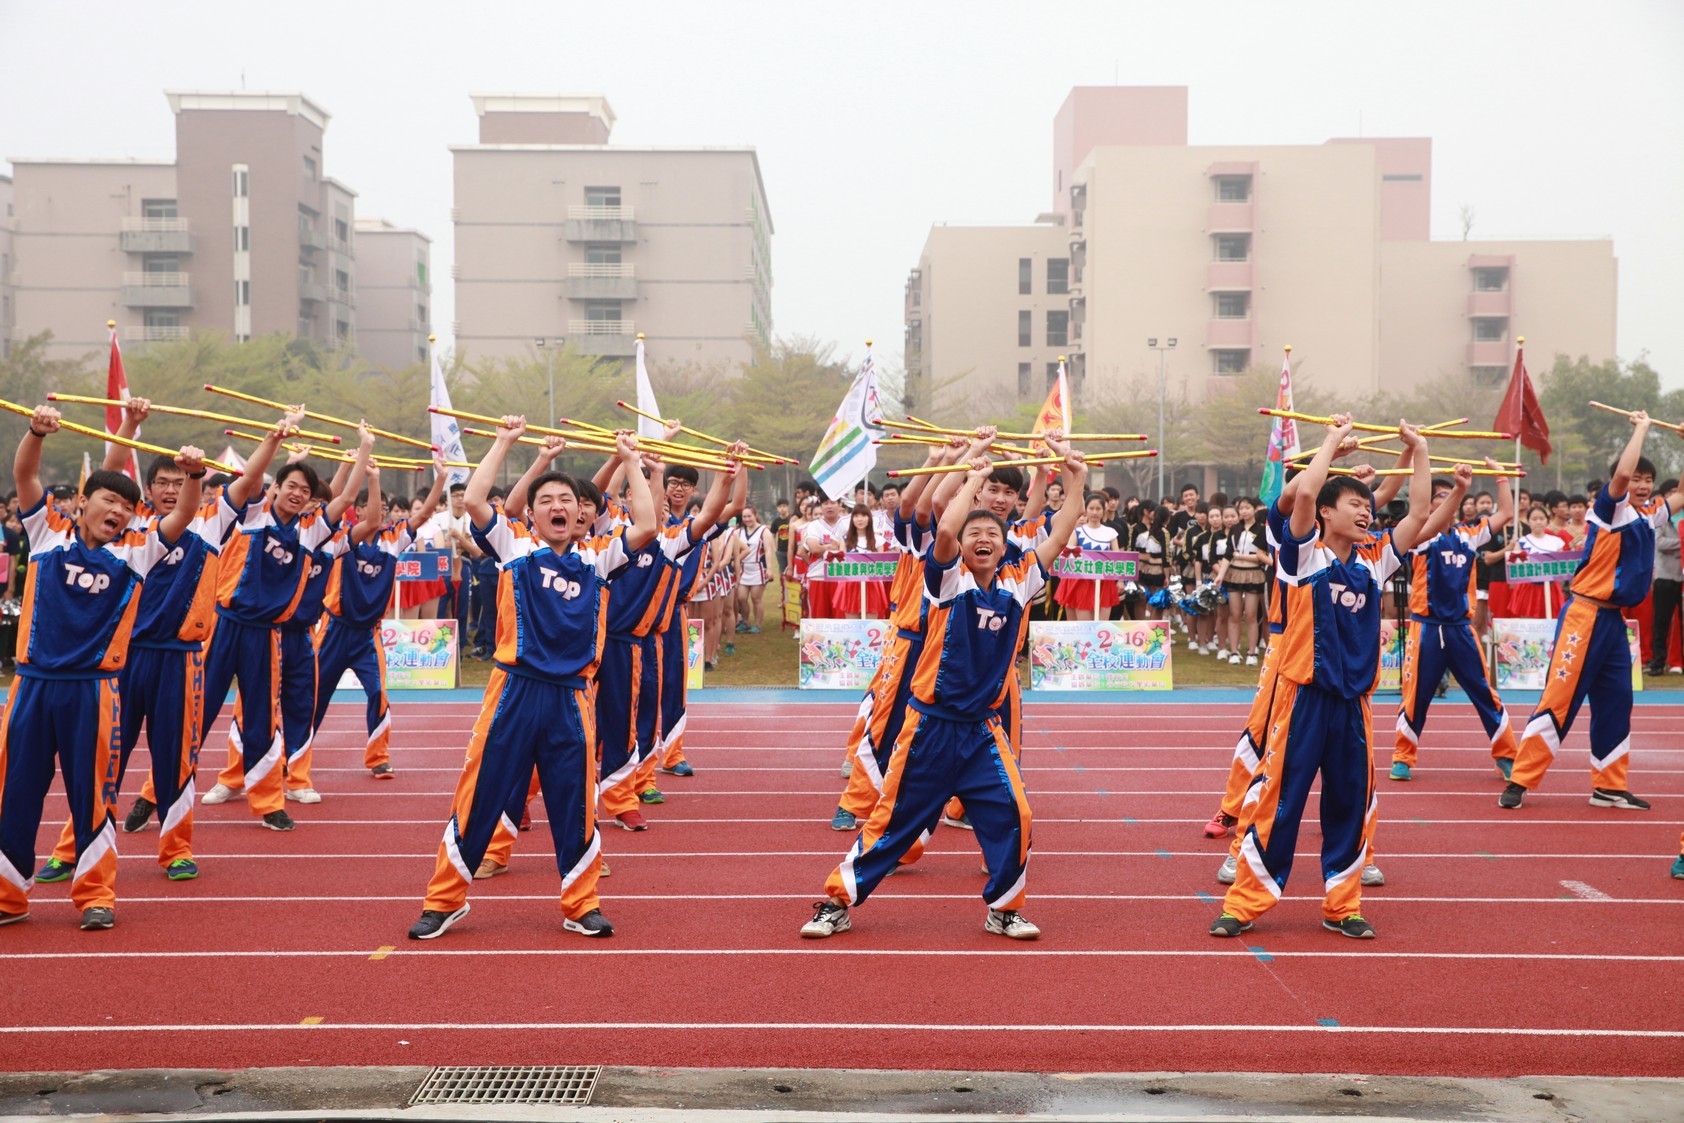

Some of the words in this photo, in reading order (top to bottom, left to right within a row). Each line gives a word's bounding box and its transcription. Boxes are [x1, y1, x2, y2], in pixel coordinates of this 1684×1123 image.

[1062, 560, 1136, 576] 人文社會科學院
[1087, 648, 1165, 670] 全校運動會
